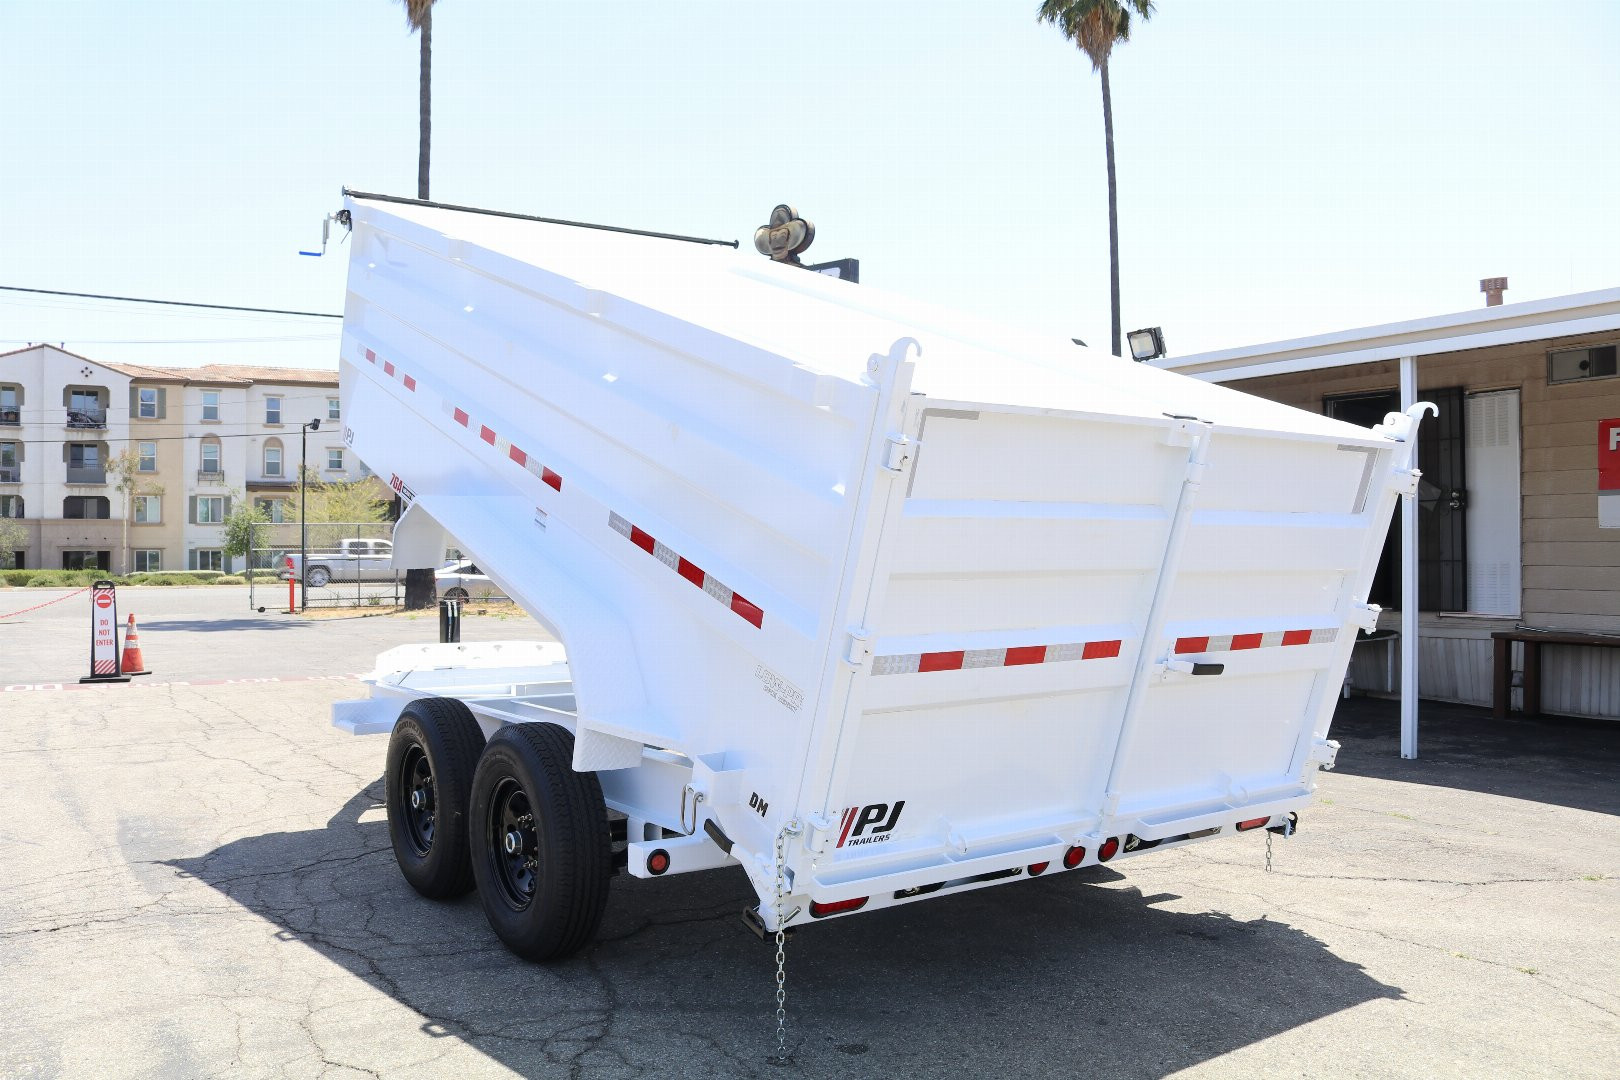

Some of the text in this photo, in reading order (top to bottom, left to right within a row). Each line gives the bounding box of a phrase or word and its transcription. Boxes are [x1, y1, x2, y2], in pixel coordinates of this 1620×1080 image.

[748, 791, 769, 818] DM
[851, 800, 906, 837] PJ
[848, 834, 891, 847] TRAILERS
